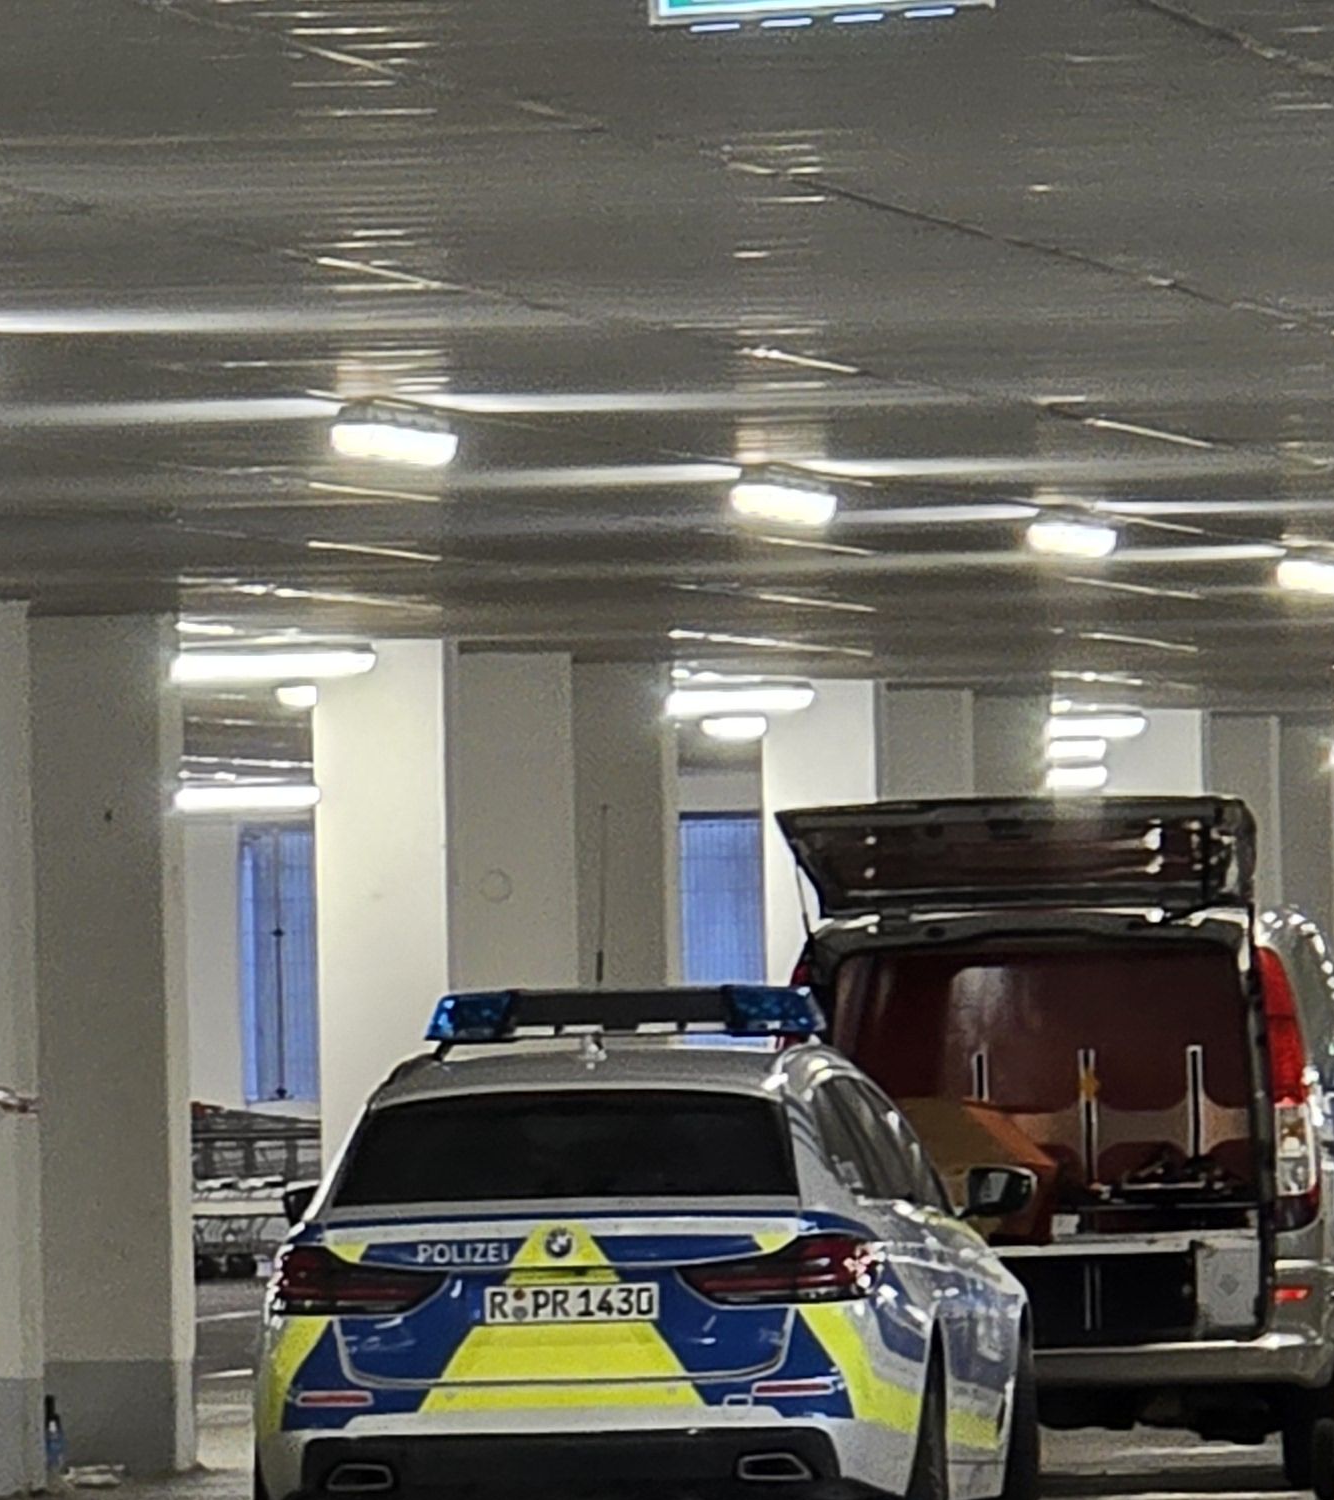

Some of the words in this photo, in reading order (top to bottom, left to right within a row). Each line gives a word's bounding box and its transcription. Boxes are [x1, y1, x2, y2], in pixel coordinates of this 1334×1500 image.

[417, 1243, 509, 1264] POLIZEI
[489, 1291, 509, 1319] R
[532, 1289, 570, 1318] PR
[577, 1288, 654, 1317] 1430
